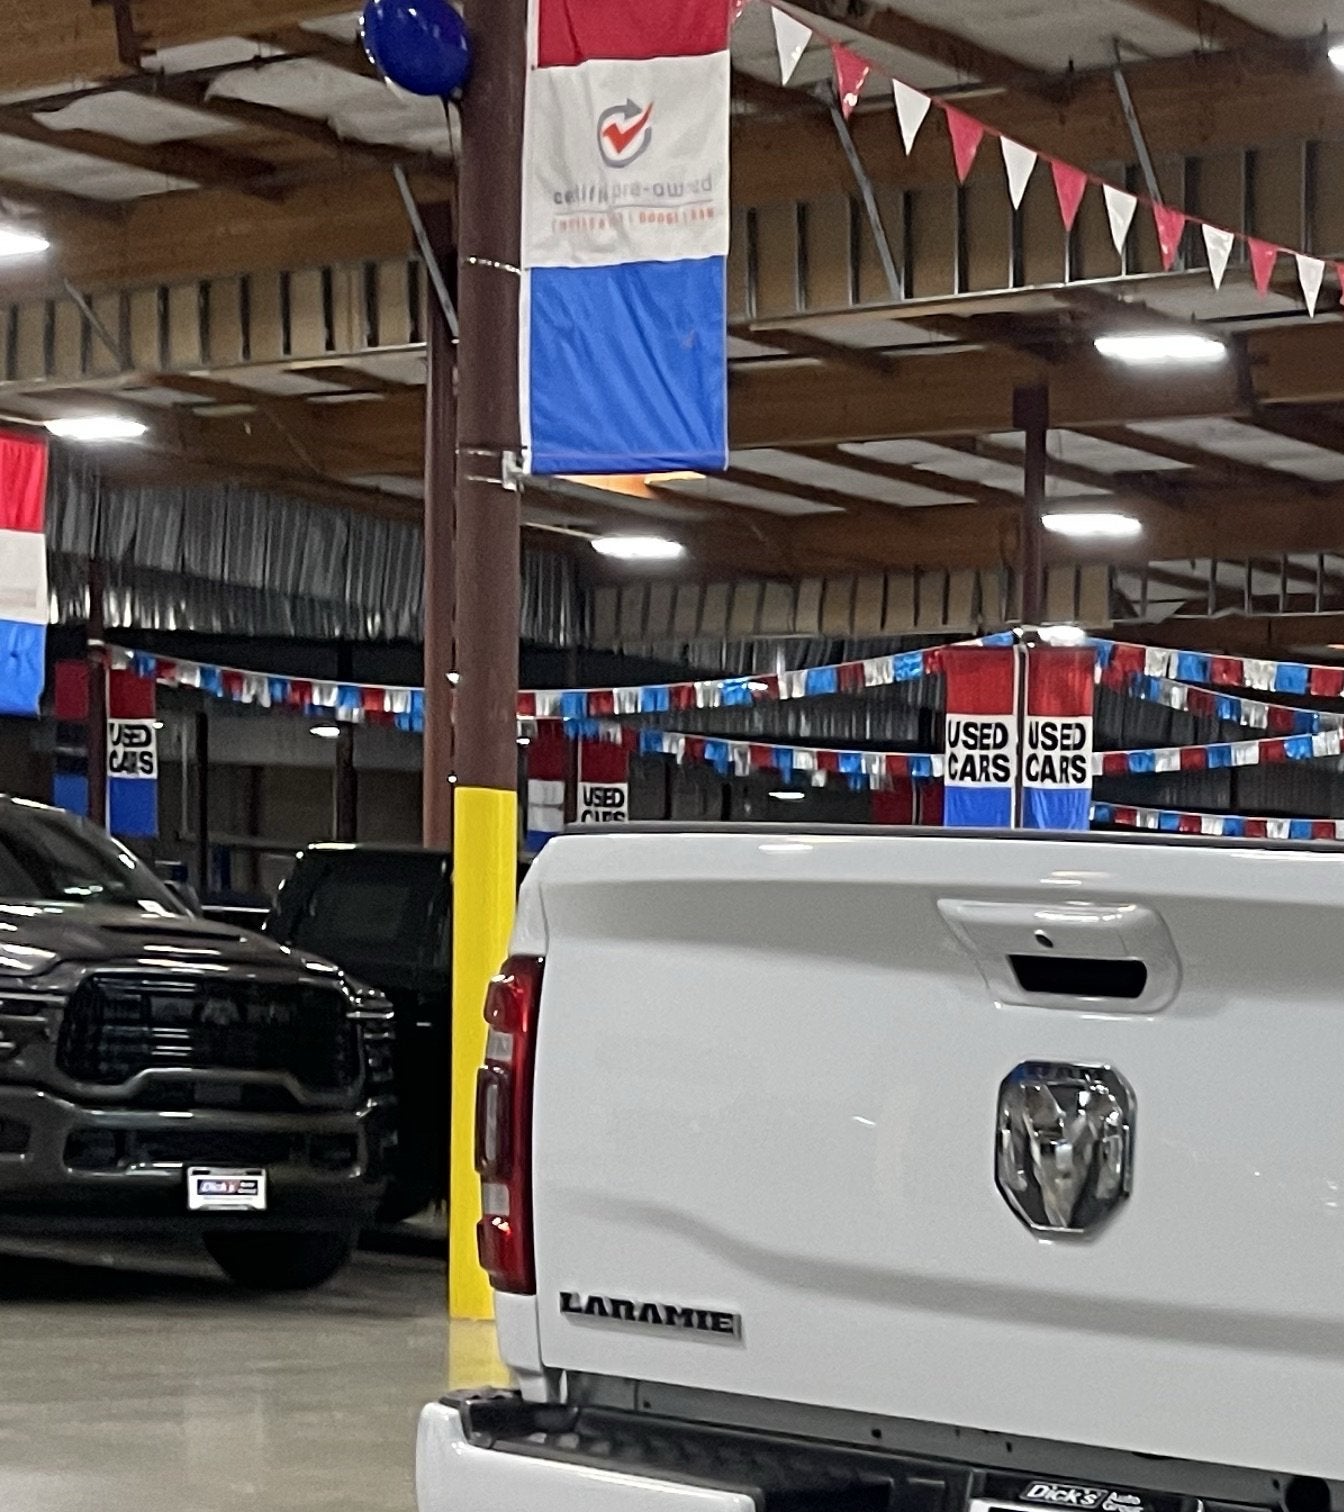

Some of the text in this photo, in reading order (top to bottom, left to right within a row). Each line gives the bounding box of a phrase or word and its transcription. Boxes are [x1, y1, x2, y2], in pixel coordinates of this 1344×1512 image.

[948, 720, 1008, 750] USED
[1028, 721, 1086, 750] USED
[948, 752, 1010, 782] CARS
[1026, 753, 1087, 784] CARS
[583, 785, 625, 808] USED
[559, 1291, 742, 1335] LARAMIE
